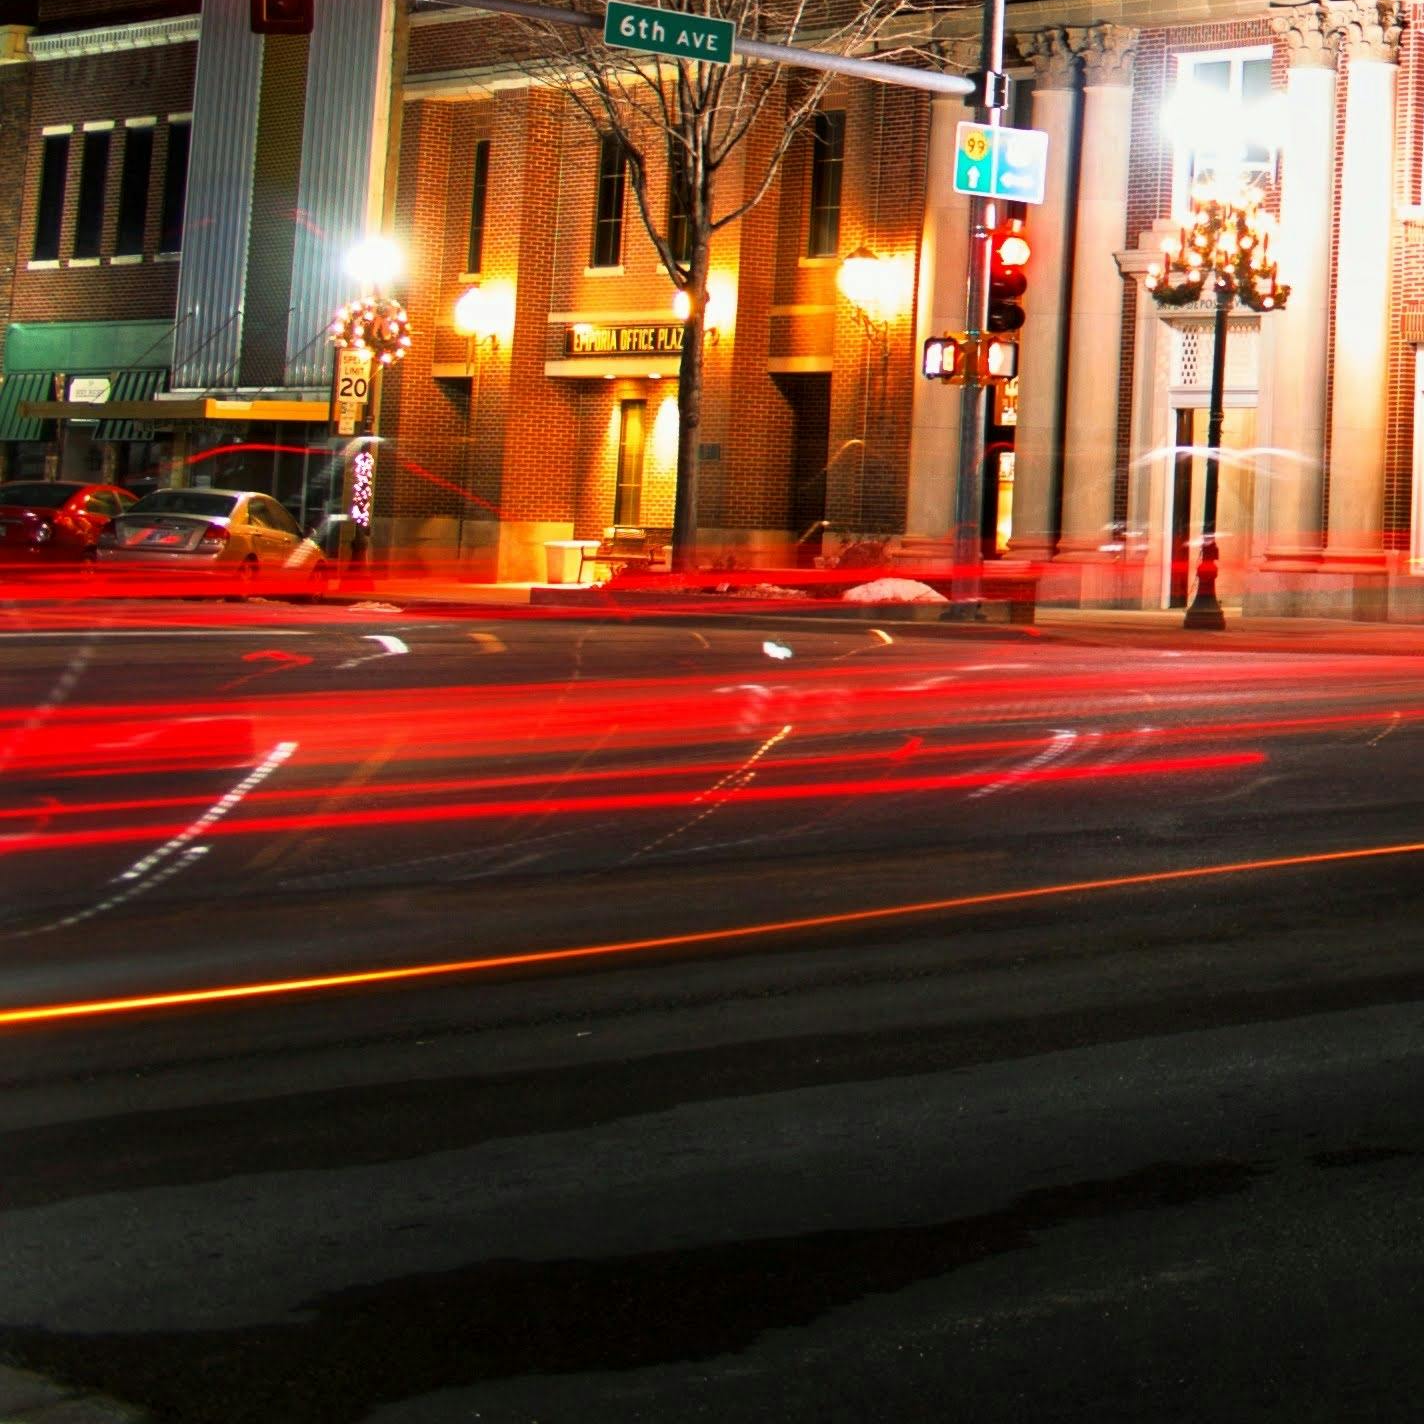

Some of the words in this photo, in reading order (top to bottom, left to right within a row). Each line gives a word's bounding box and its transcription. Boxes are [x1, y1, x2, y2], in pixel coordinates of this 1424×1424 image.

[619, 14, 666, 43] 6th
[676, 29, 719, 51] AVE
[573, 327, 617, 352] EMPORIA
[619, 327, 655, 351] OFFICE
[657, 327, 685, 351] PLAZ
[344, 367, 365, 376] LIMIT
[339, 377, 367, 398] 20
